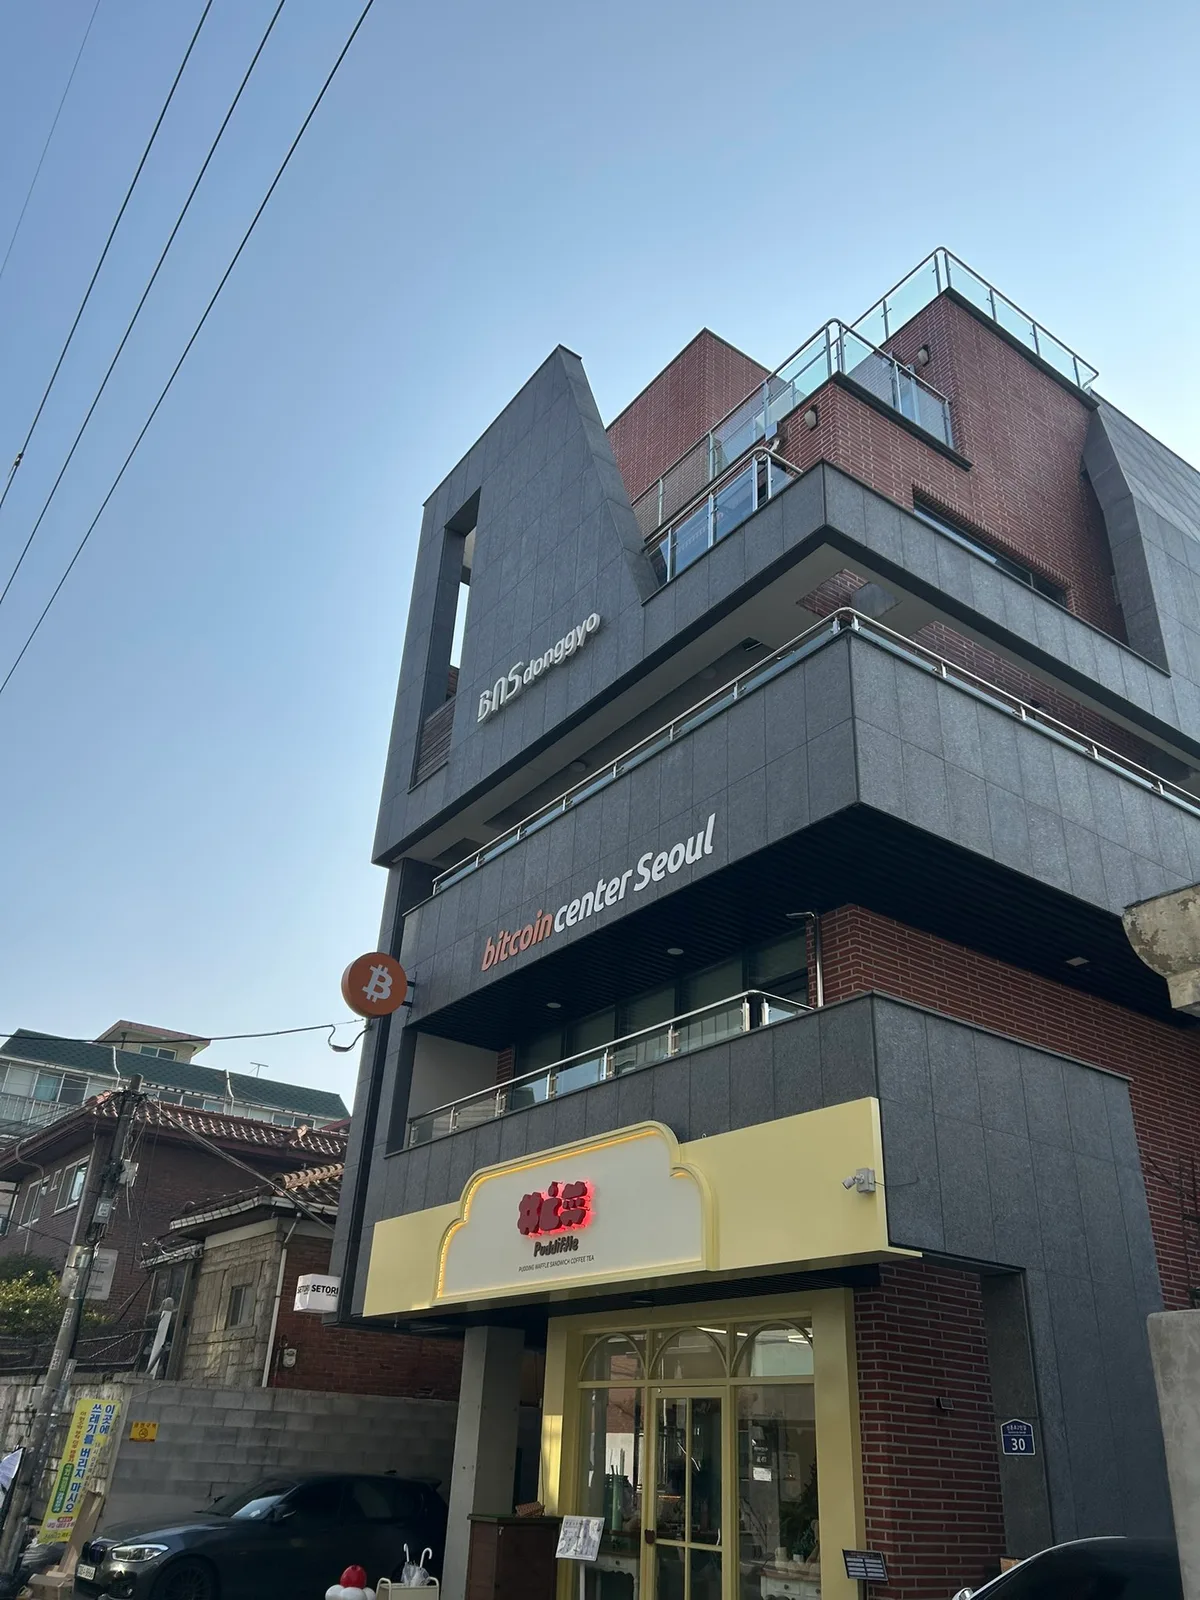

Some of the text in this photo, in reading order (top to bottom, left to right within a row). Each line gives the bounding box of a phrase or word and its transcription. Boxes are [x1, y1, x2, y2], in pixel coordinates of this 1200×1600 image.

[633, 813, 716, 892] Seoul
[518, 1255, 595, 1273] PUDDING WAFFLE SANDWICH COFFEE TEA
[311, 1284, 339, 1295] SETORI
[84, 1403, 102, 1445] 쓰레기를
[99, 1404, 115, 1434] 이곳에
[1010, 1437, 1026, 1451] 30
[74, 1447, 91, 1479] 버리지
[64, 1482, 82, 1513] 마시오
